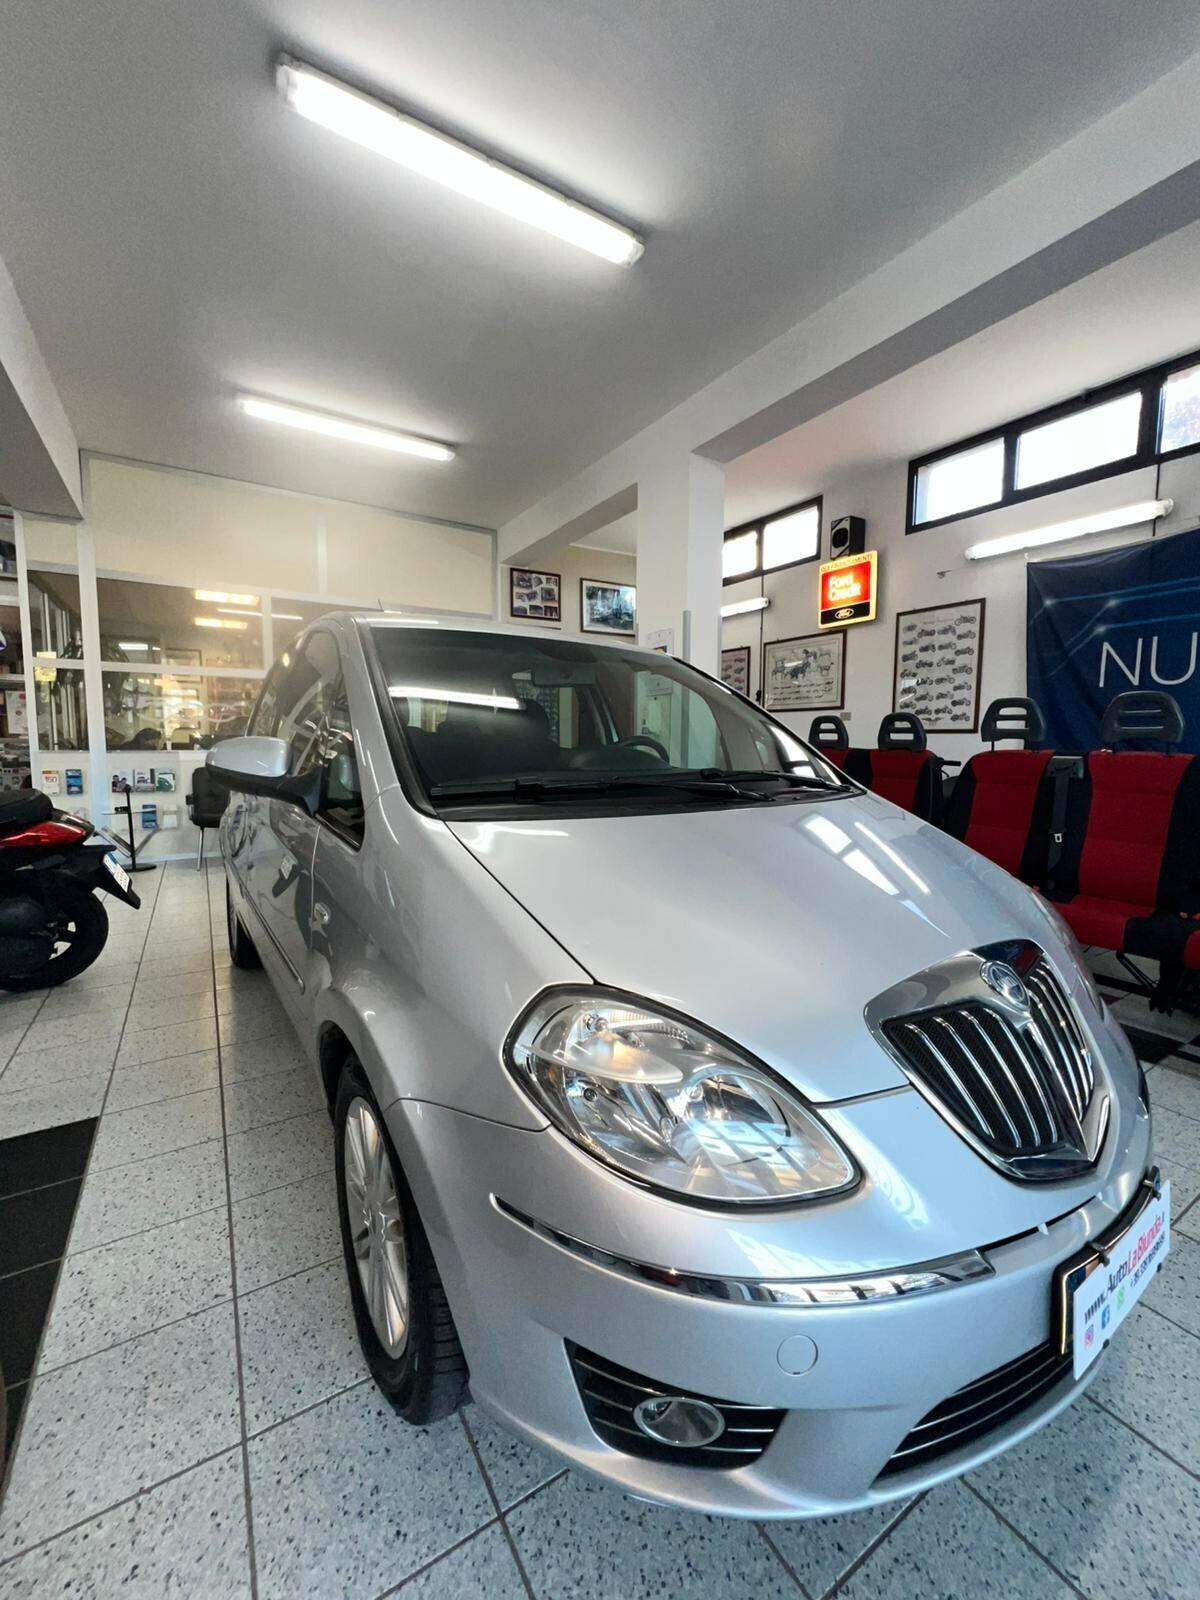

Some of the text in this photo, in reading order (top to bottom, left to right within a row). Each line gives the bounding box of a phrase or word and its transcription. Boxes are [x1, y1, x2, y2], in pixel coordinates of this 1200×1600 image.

[828, 572, 855, 589] Ford
[828, 582, 862, 602] Credit
[1099, 631, 1198, 688] NU
